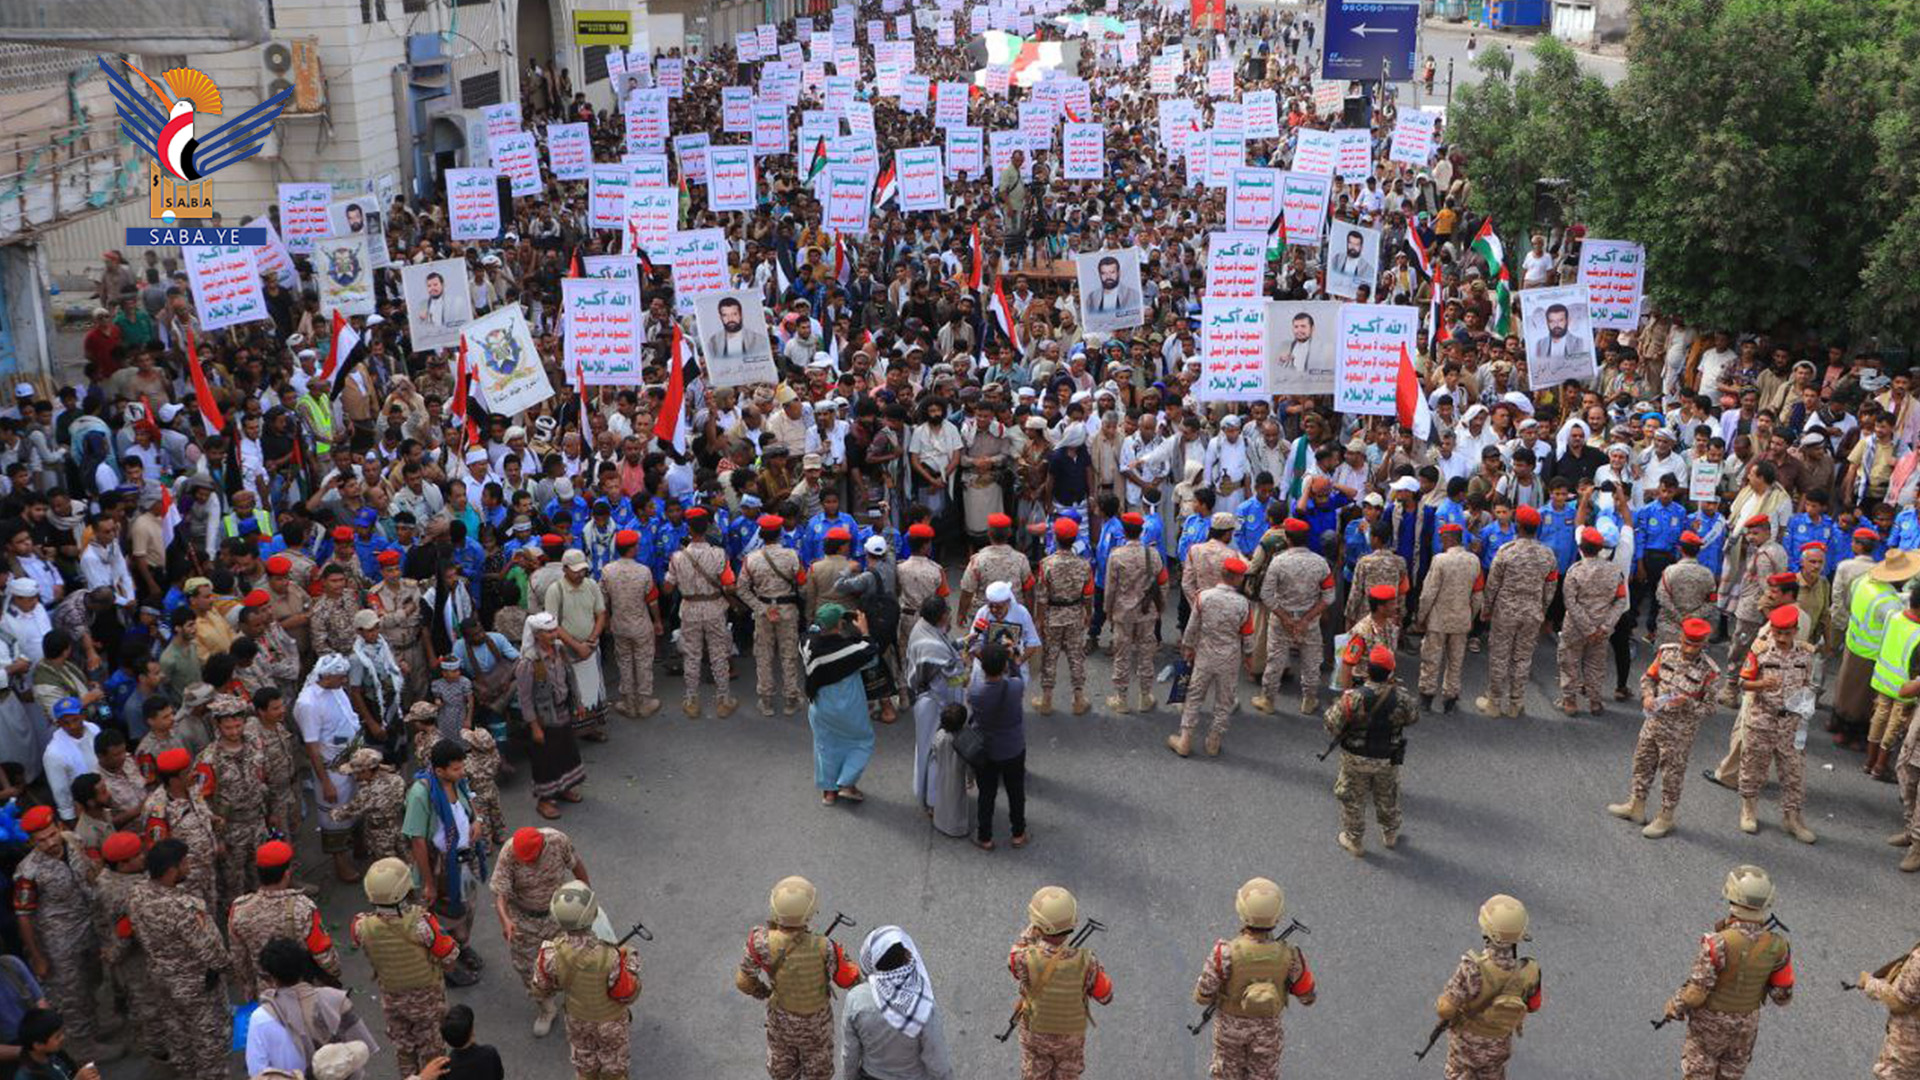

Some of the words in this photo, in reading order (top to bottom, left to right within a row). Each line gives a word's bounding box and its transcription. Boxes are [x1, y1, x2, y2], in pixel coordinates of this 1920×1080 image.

[574, 288, 610, 310] أكبر
[610, 291, 632, 306] الله
[1210, 306, 1243, 327] أكبر
[1244, 308, 1264, 323] الله
[1347, 316, 1384, 337] أكبر
[1385, 319, 1407, 334] الله
[607, 358, 633, 374] النصر
[1208, 375, 1237, 391] للإسلام
[1239, 374, 1262, 391] النصر
[1343, 387, 1374, 405] للإسلام
